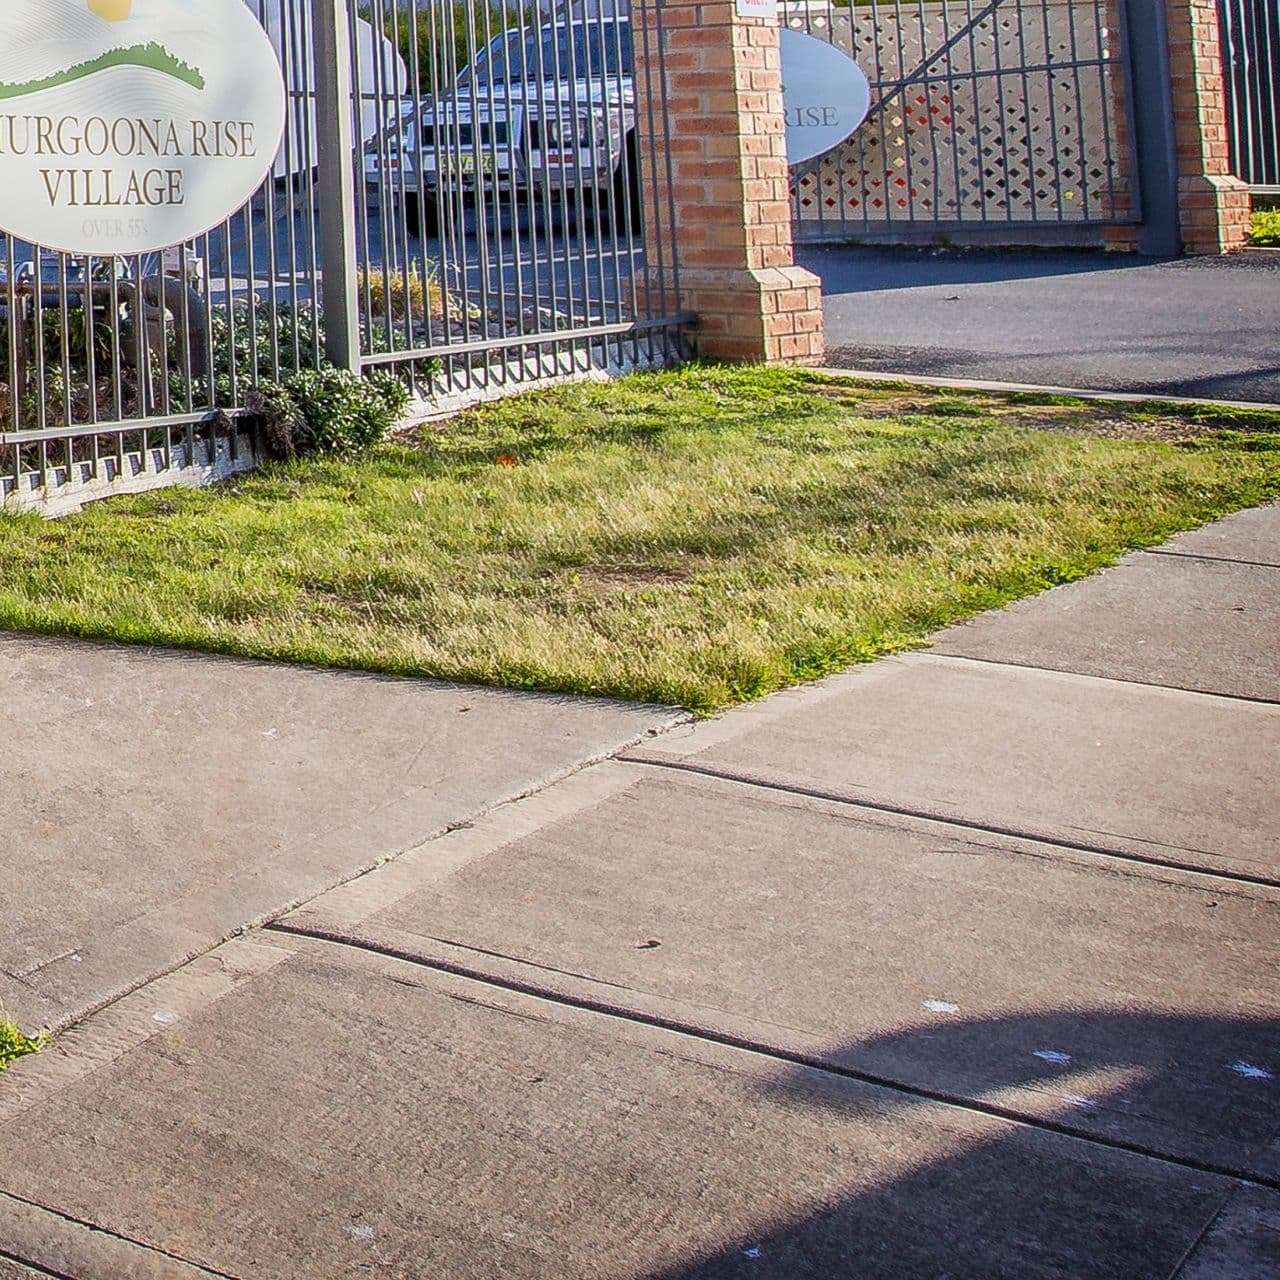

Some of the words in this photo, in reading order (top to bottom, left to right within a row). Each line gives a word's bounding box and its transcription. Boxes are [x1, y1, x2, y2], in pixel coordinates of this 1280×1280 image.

[189, 120, 256, 158] RISE
[39, 168, 184, 206] VILLAGE
[81, 218, 124, 238] OVER
